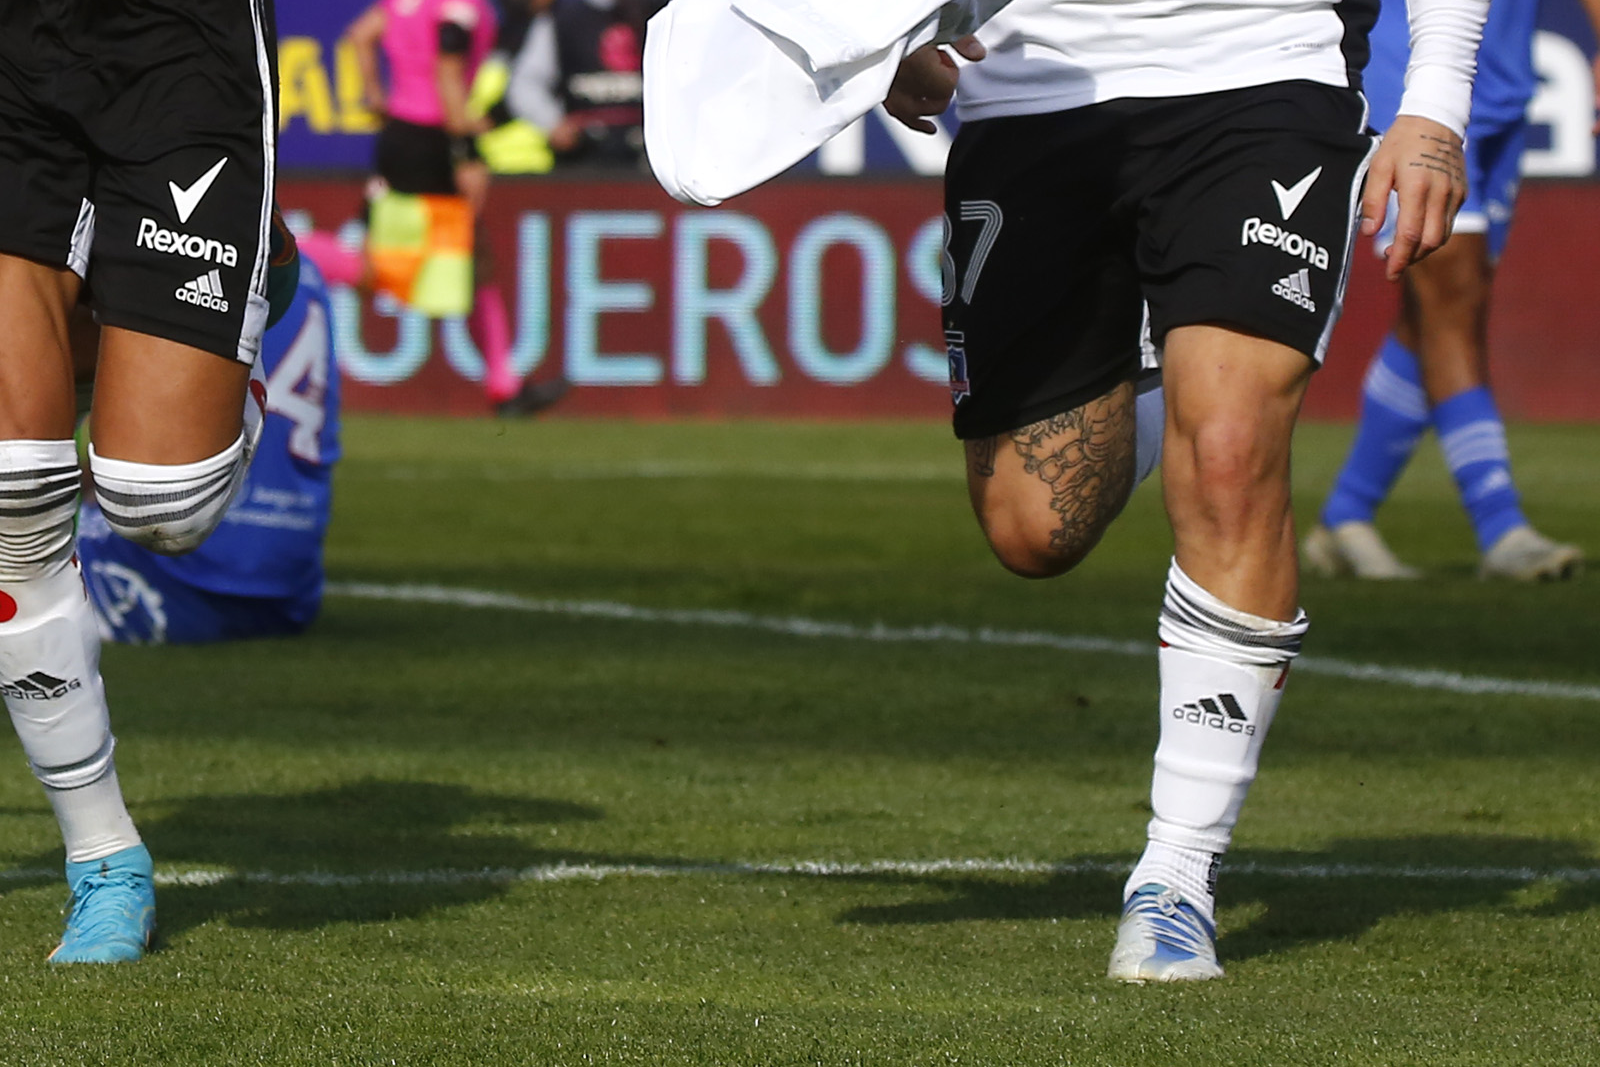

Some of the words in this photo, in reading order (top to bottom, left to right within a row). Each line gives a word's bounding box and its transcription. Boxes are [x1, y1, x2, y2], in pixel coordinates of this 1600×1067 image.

[136, 217, 239, 268] Rexona
[1241, 217, 1330, 271] Rexona
[175, 287, 230, 313] adidas
[1271, 283, 1316, 313] adidas
[1172, 706, 1257, 737] adidas
